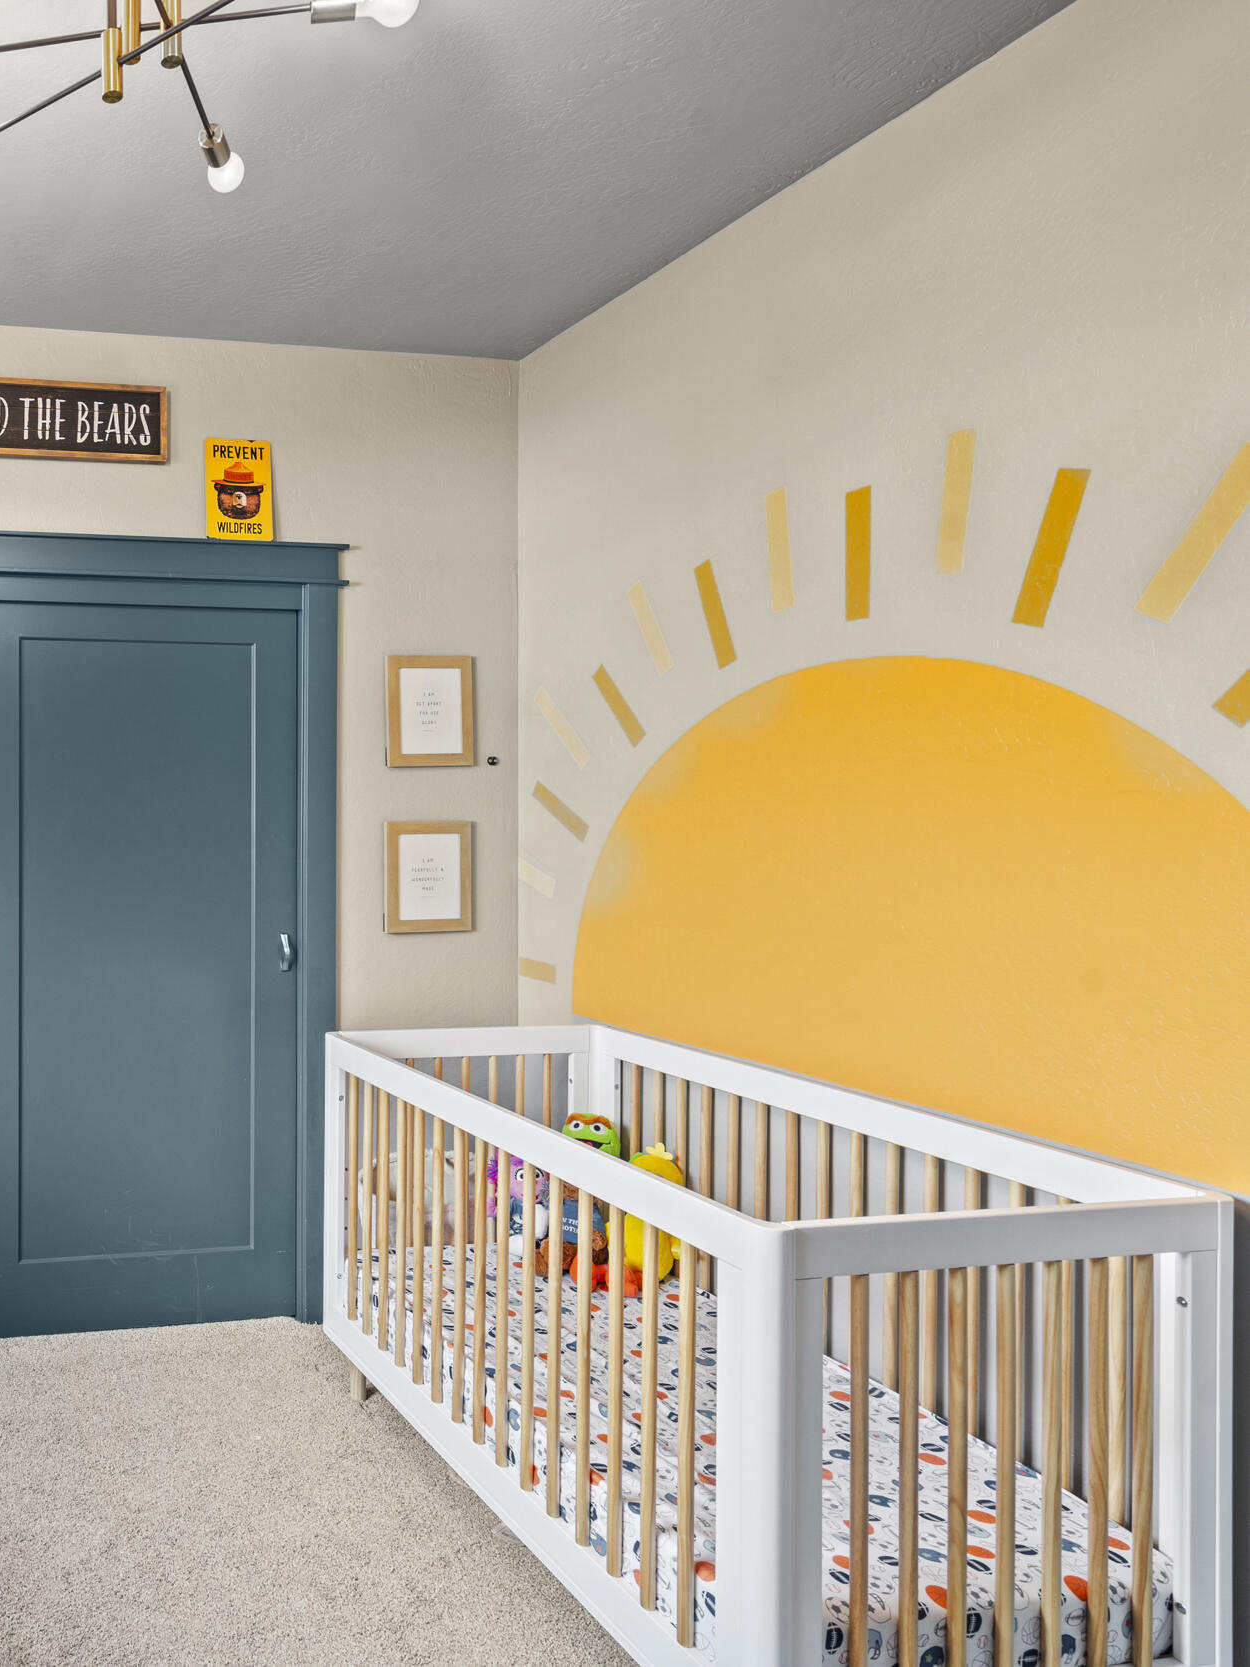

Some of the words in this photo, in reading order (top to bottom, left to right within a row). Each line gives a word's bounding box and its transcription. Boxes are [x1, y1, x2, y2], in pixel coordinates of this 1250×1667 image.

[19, 397, 66, 441] THE
[76, 401, 151, 446] BEARS
[213, 444, 265, 461] PREVENT
[217, 521, 263, 535] WILDFIRES
